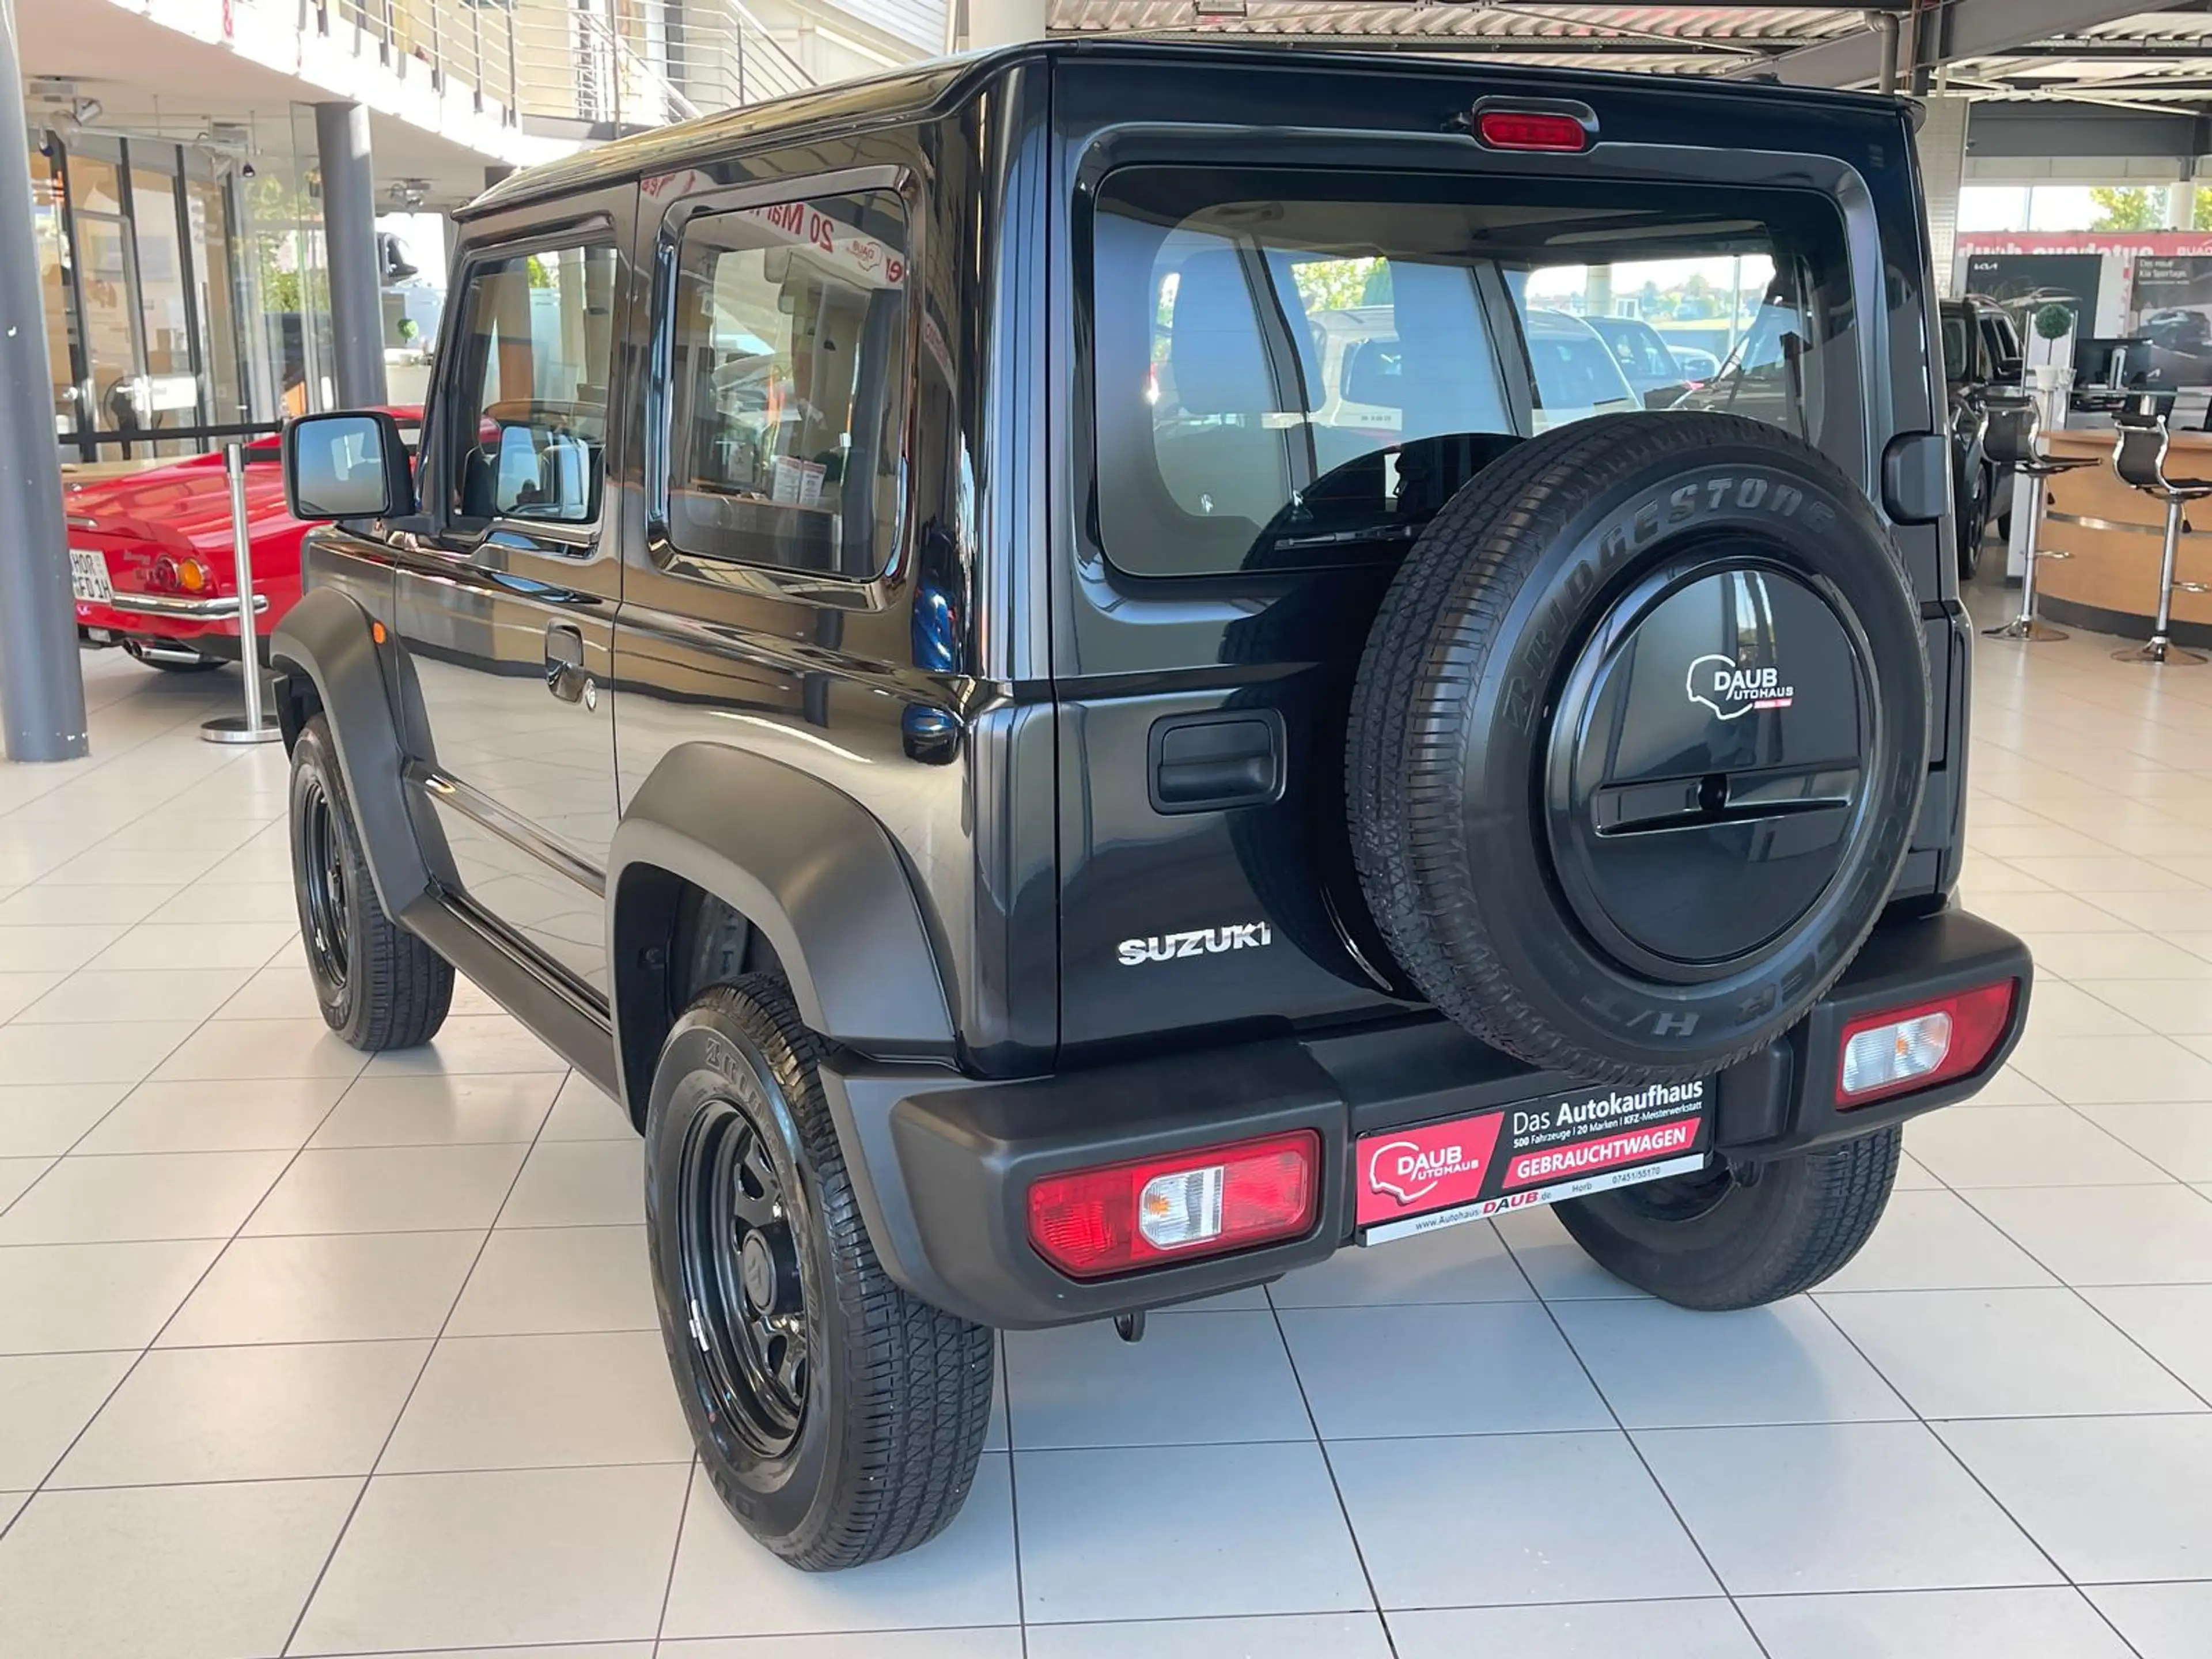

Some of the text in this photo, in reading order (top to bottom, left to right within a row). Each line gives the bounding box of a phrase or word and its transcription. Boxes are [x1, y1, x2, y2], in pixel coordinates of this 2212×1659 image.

[1714, 667, 1778, 701] DAUB
[1118, 921, 1272, 965] SUZUKI
[1513, 1080, 1703, 1136] Das Autokaufhaus
[1513, 1101, 1702, 1149] 500 Fahrzeuge 20 Marken KFZ-Meisterwerkstatt
[1397, 1146, 1463, 1182] DAUB
[1517, 1126, 1687, 1179] GEBRAUCHTWAGEN
[1572, 1183, 1592, 1192] Horb
